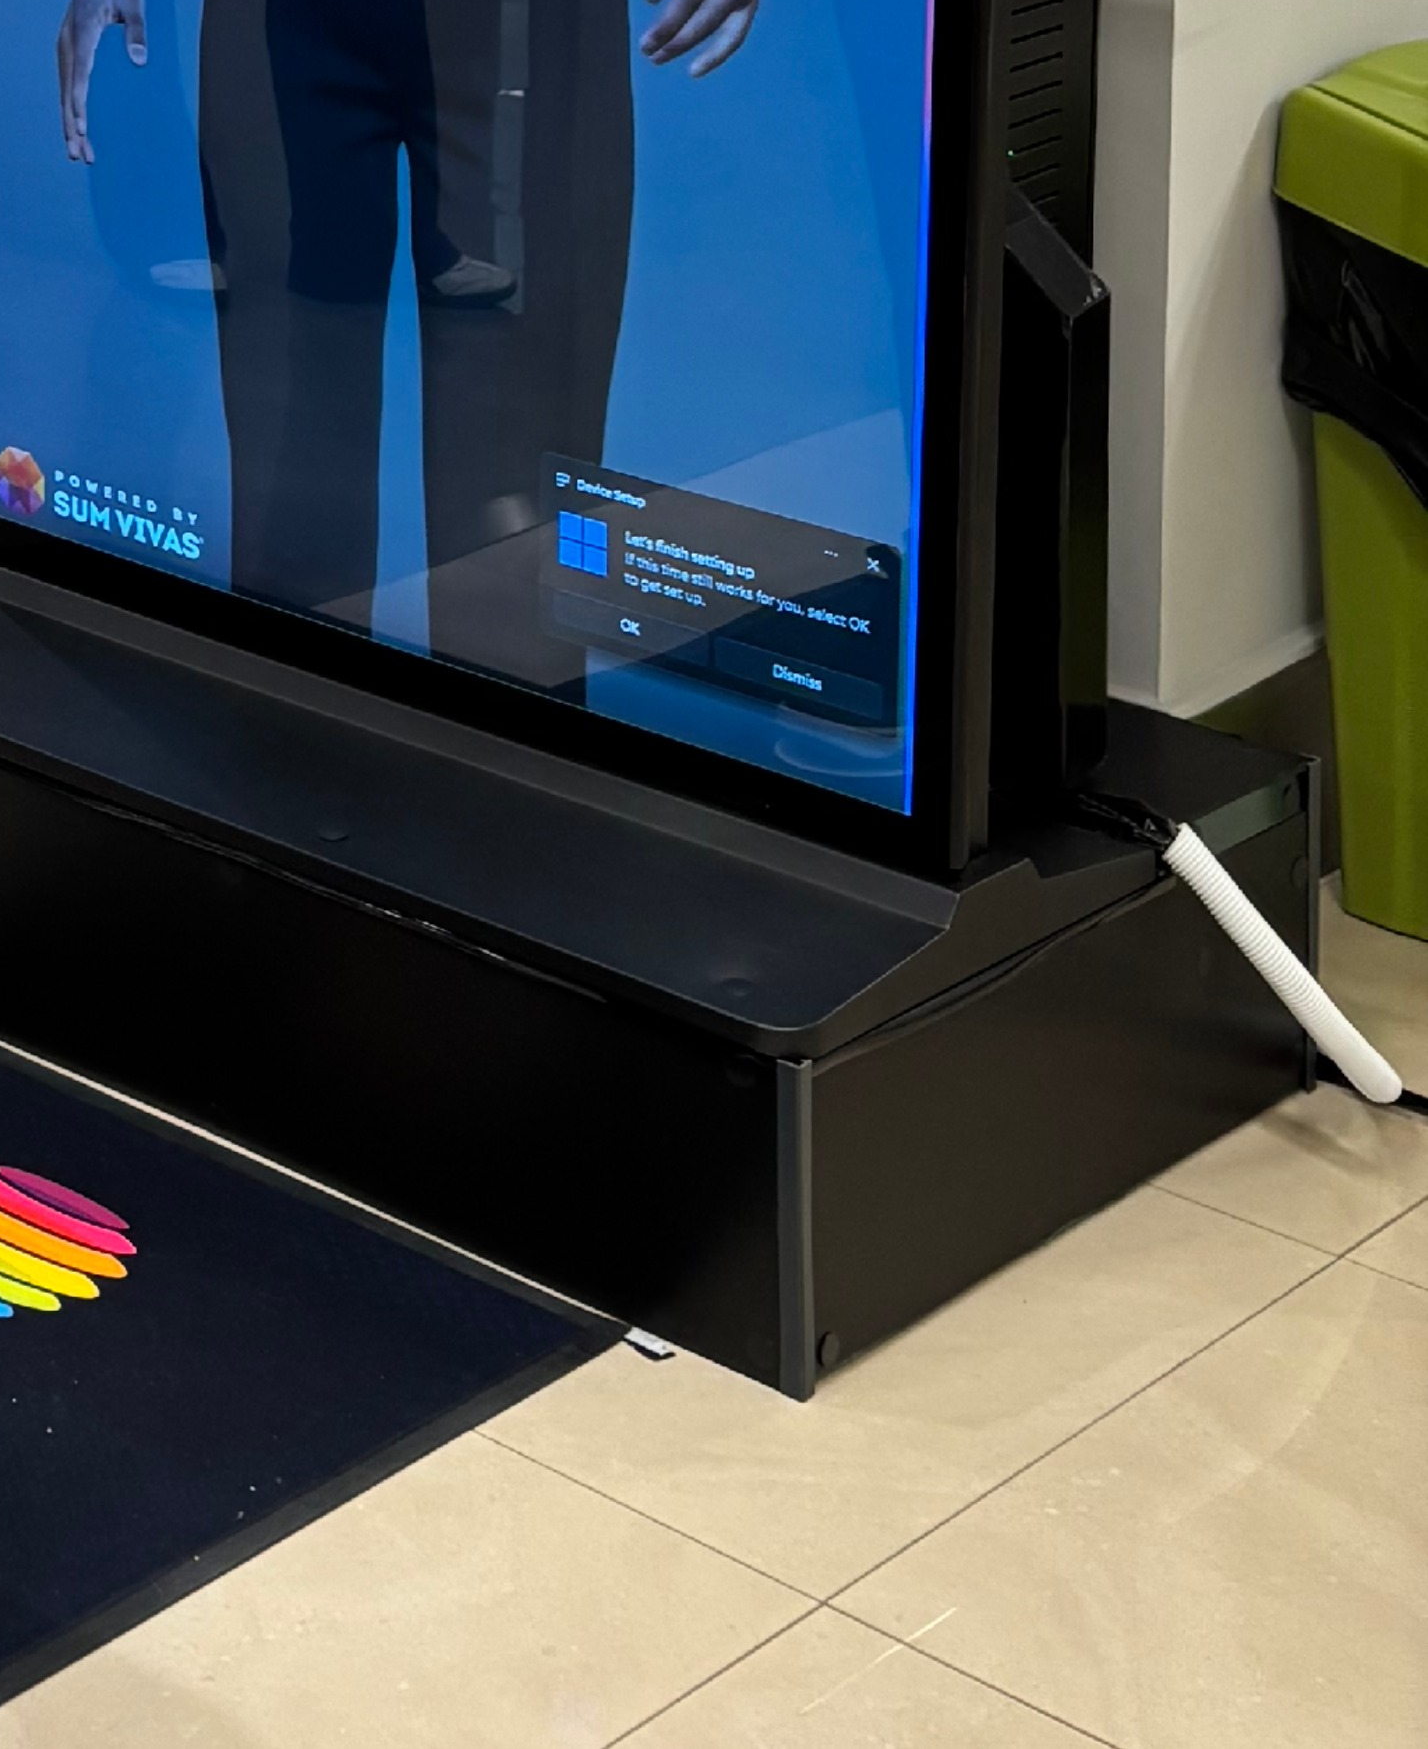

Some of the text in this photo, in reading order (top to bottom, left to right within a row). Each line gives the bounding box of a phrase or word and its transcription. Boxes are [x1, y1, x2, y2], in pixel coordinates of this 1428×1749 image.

[54, 470, 197, 525] POWERED BY
[576, 479, 613, 499] Device
[54, 490, 201, 559] SUM VIVAS
[625, 531, 755, 580] Let's finish setting up
[624, 573, 639, 586] to
[641, 578, 662, 593] get
[663, 585, 684, 600] set
[636, 557, 660, 573] this
[661, 563, 690, 582] time
[691, 573, 713, 589] still
[715, 581, 753, 600] works
[756, 589, 775, 606] for
[776, 598, 805, 616] you,
[807, 607, 847, 627] select
[848, 617, 871, 634] OK
[619, 618, 641, 636] OK
[772, 663, 822, 691] Dismiss
